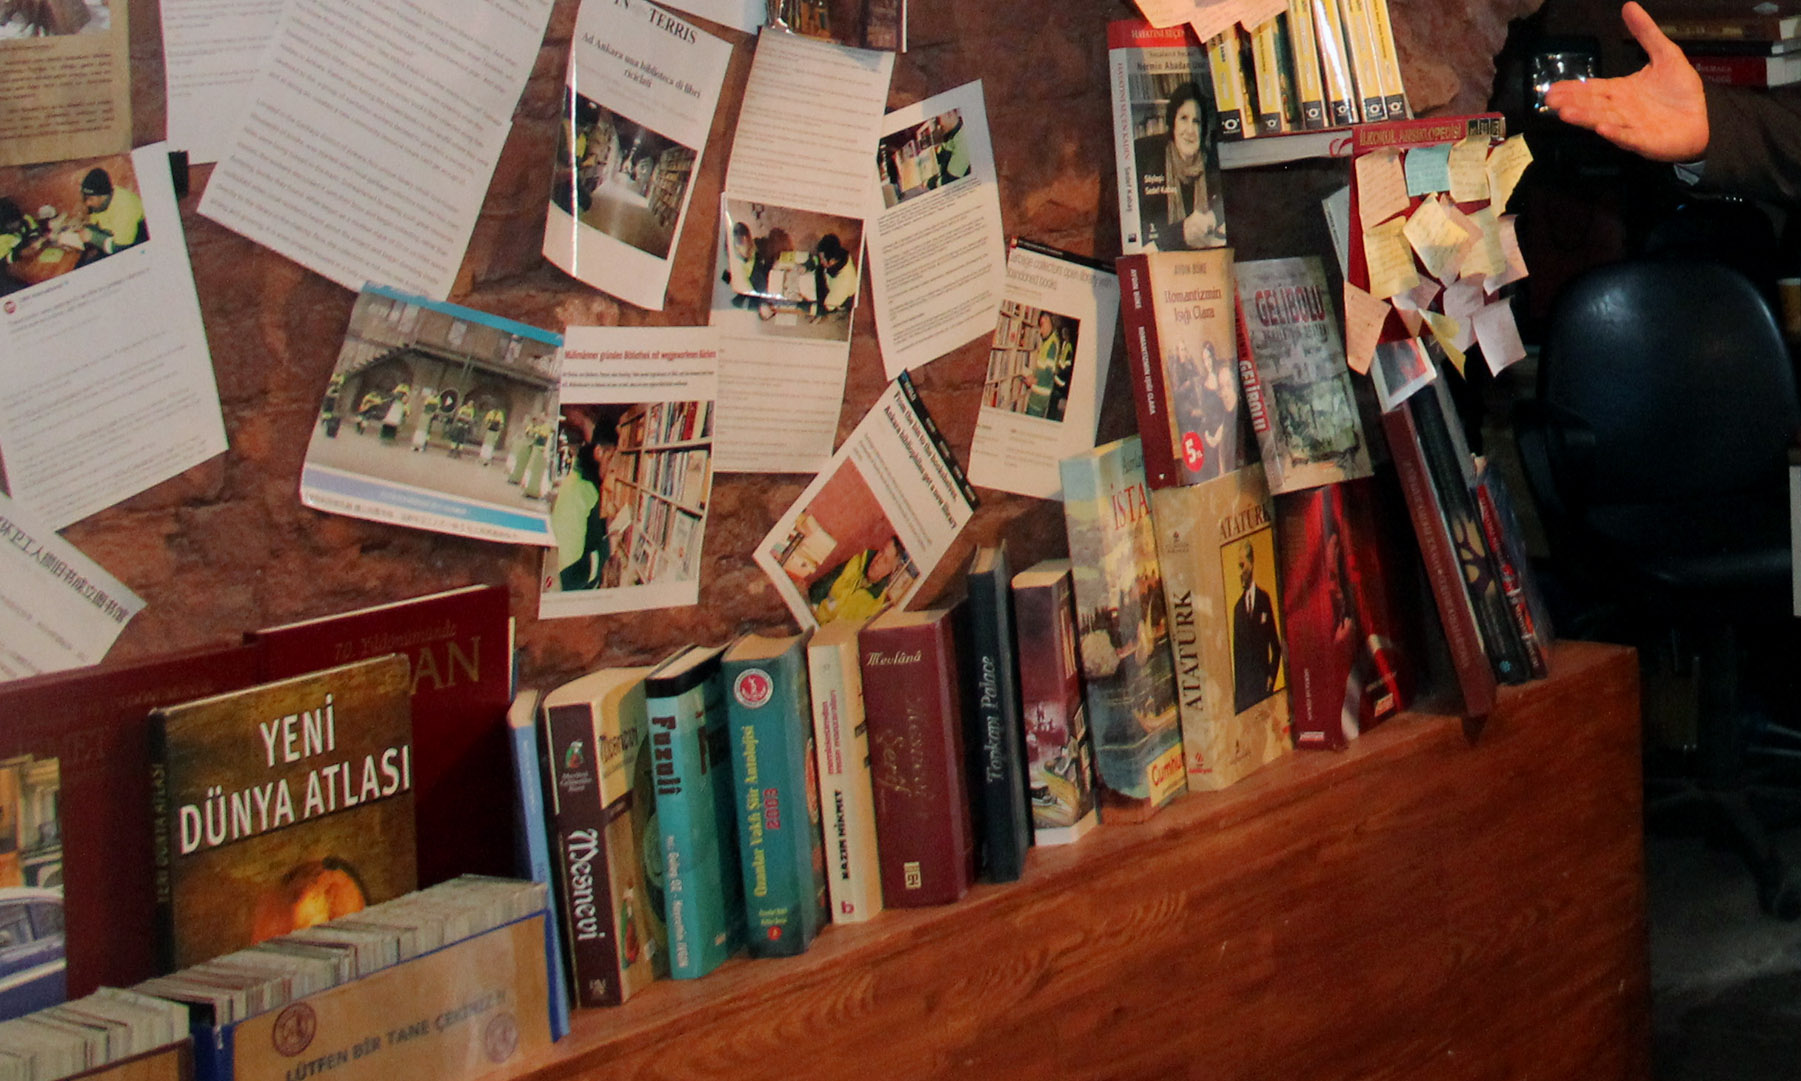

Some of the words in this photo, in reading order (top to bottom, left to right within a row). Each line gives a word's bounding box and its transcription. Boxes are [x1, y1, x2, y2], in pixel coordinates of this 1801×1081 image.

[647, 8, 697, 45] TERRIS
[580, 31, 595, 45] Ad
[595, 38, 625, 59] Ankara
[625, 53, 642, 67] una
[640, 59, 676, 86] biblioteca
[673, 78, 685, 90] di
[682, 82, 703, 99] libri
[1163, 284, 1223, 303] Romantizmin
[1254, 284, 1326, 327] GELİBOLU
[565, 350, 598, 359] Müllmänner
[599, 351, 623, 362] gründen
[624, 350, 650, 359] Bibliothek
[1238, 358, 1267, 432] GELİBOLU
[892, 390, 909, 412] From
[903, 410, 915, 424] the
[910, 422, 923, 437] bin
[921, 442, 935, 458] the
[882, 404, 904, 434] Ankara
[897, 430, 928, 474] bibliophiles
[921, 471, 934, 485] get
[931, 489, 946, 505] new
[939, 502, 960, 529] library
[1109, 478, 1152, 530] İSTA
[1218, 500, 1271, 540] ATATÜRK
[406, 637, 484, 695] AN
[866, 649, 922, 665] Mevlânâ
[1174, 590, 1203, 710] ATATÜRK
[979, 655, 997, 710] Palace
[259, 693, 336, 768] YENİ
[651, 715, 683, 797] Fuzulî
[179, 779, 296, 855] DÜNYA
[303, 744, 411, 820] ATLASI
[760, 786, 782, 830] 2003
[832, 788, 845, 836] HİKMET
[567, 827, 607, 941] Mesnevi
[838, 838, 850, 880] NAZIM
[285, 1049, 348, 1081] LÜTFEN
[352, 1036, 381, 1059] BİR
[387, 1020, 429, 1045] TANE
